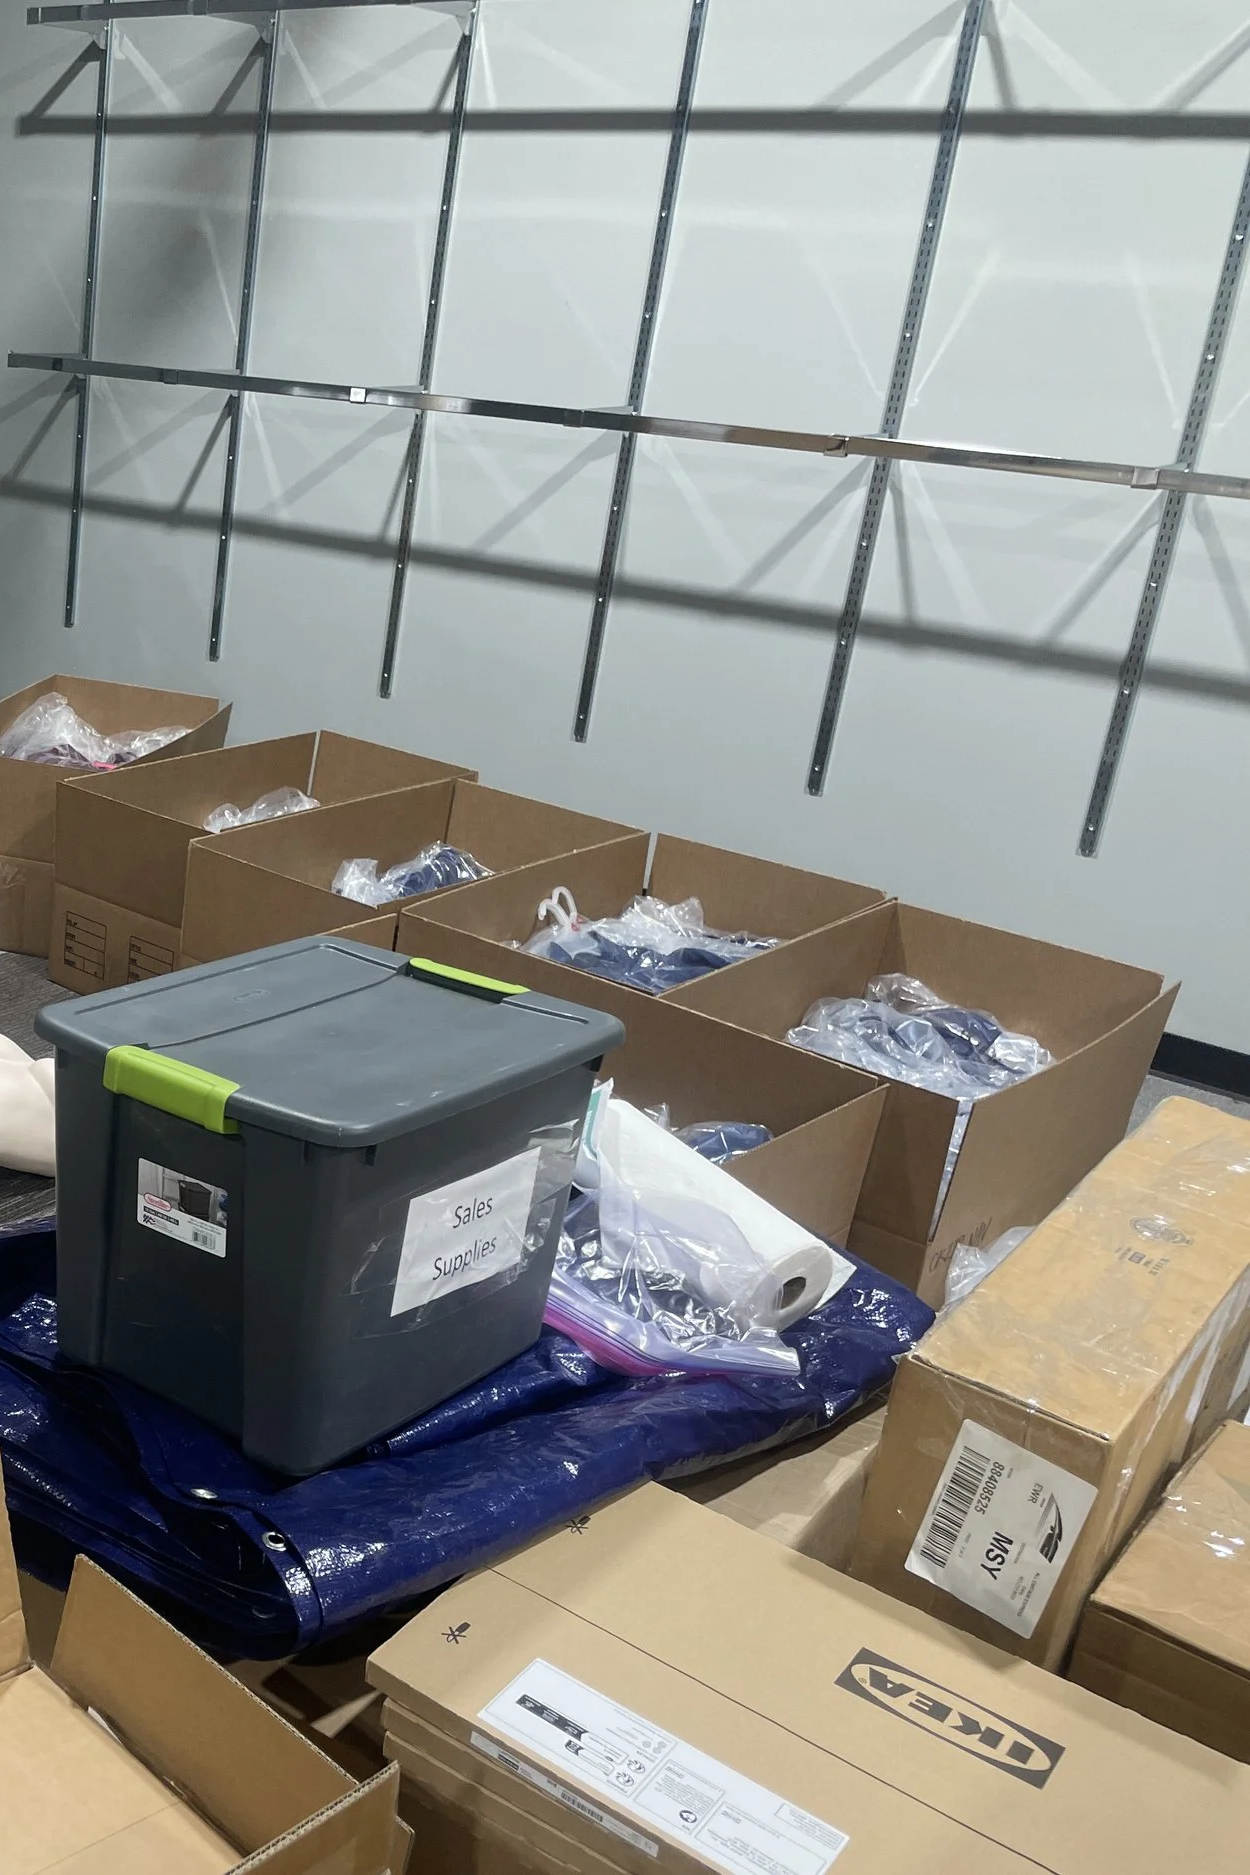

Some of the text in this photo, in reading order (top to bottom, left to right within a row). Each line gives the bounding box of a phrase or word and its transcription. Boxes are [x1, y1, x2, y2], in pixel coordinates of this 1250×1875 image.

[452, 1195, 493, 1230] Sales
[432, 1237, 497, 1281] Supplies
[974, 1461, 1005, 1515] 88408525
[1027, 1482, 1043, 1504] EWR
[980, 1531, 1014, 1581] MSY
[868, 1666, 1034, 1765] IKEA
